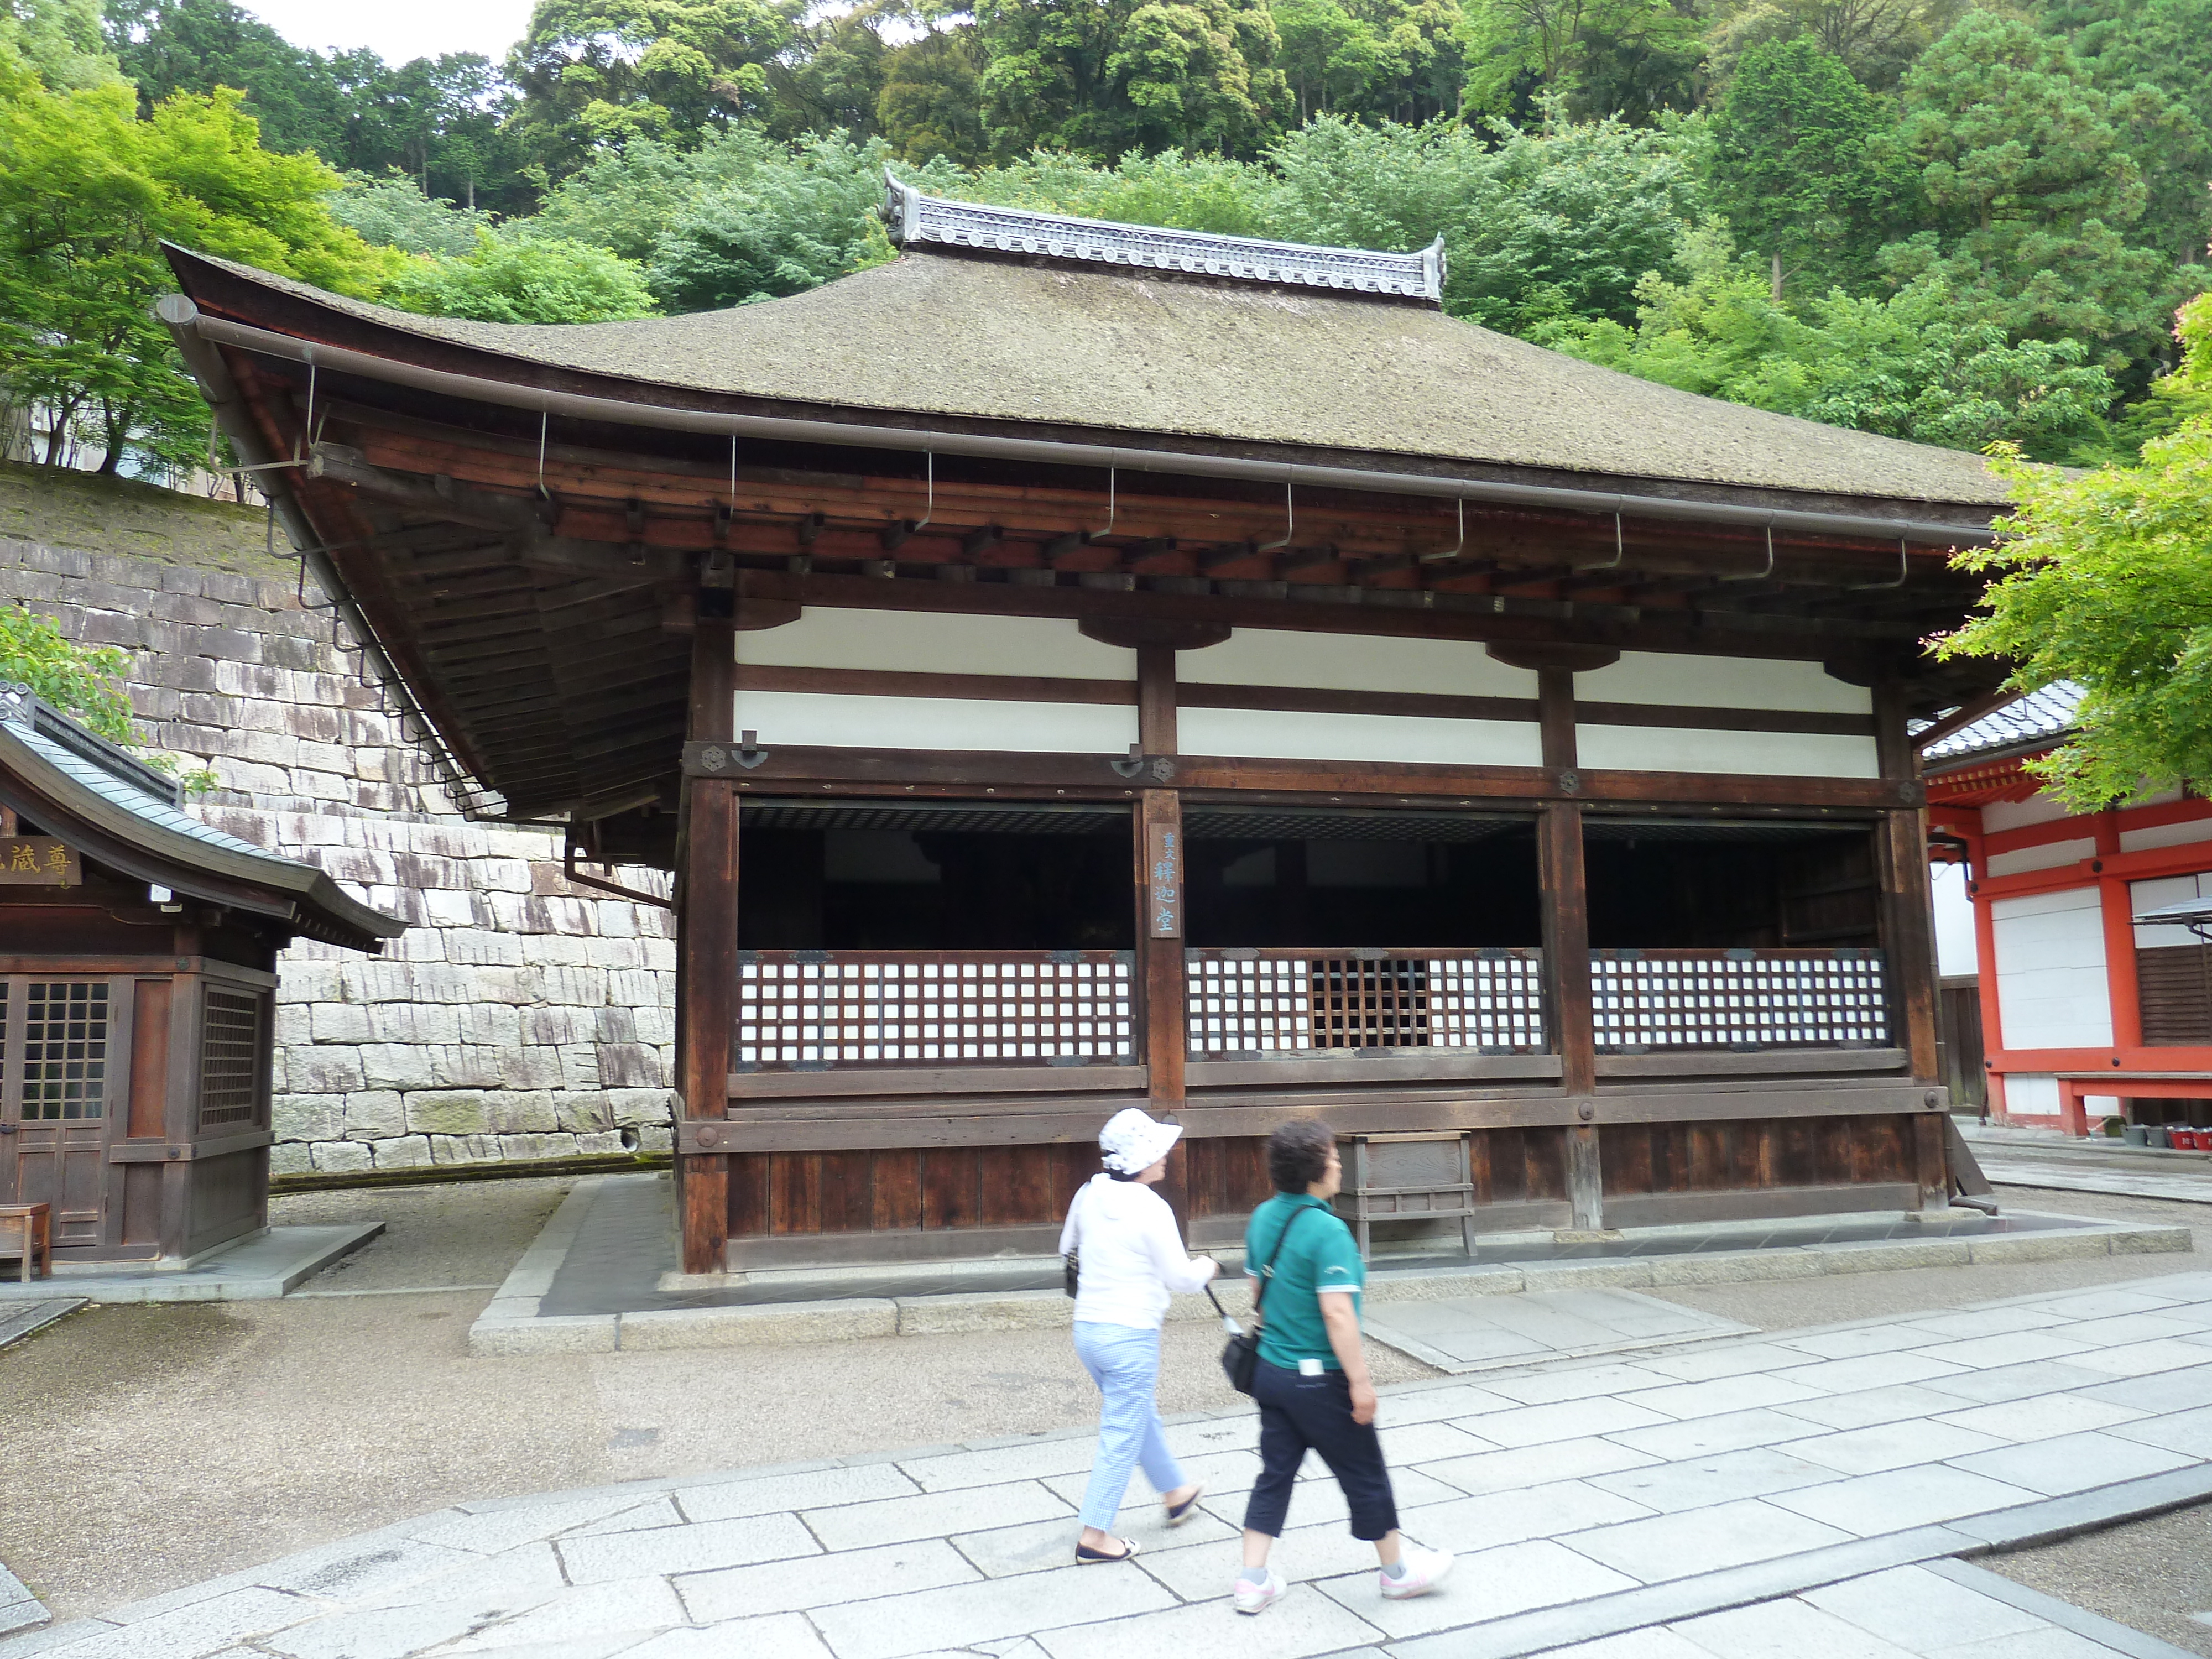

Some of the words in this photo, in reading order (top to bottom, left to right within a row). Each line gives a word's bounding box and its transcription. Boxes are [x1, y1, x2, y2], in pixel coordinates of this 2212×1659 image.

[0, 844, 72, 876] 蔵尊
[1163, 832, 1176, 859] 重文
[1154, 861, 1176, 931] 釋迦堂
